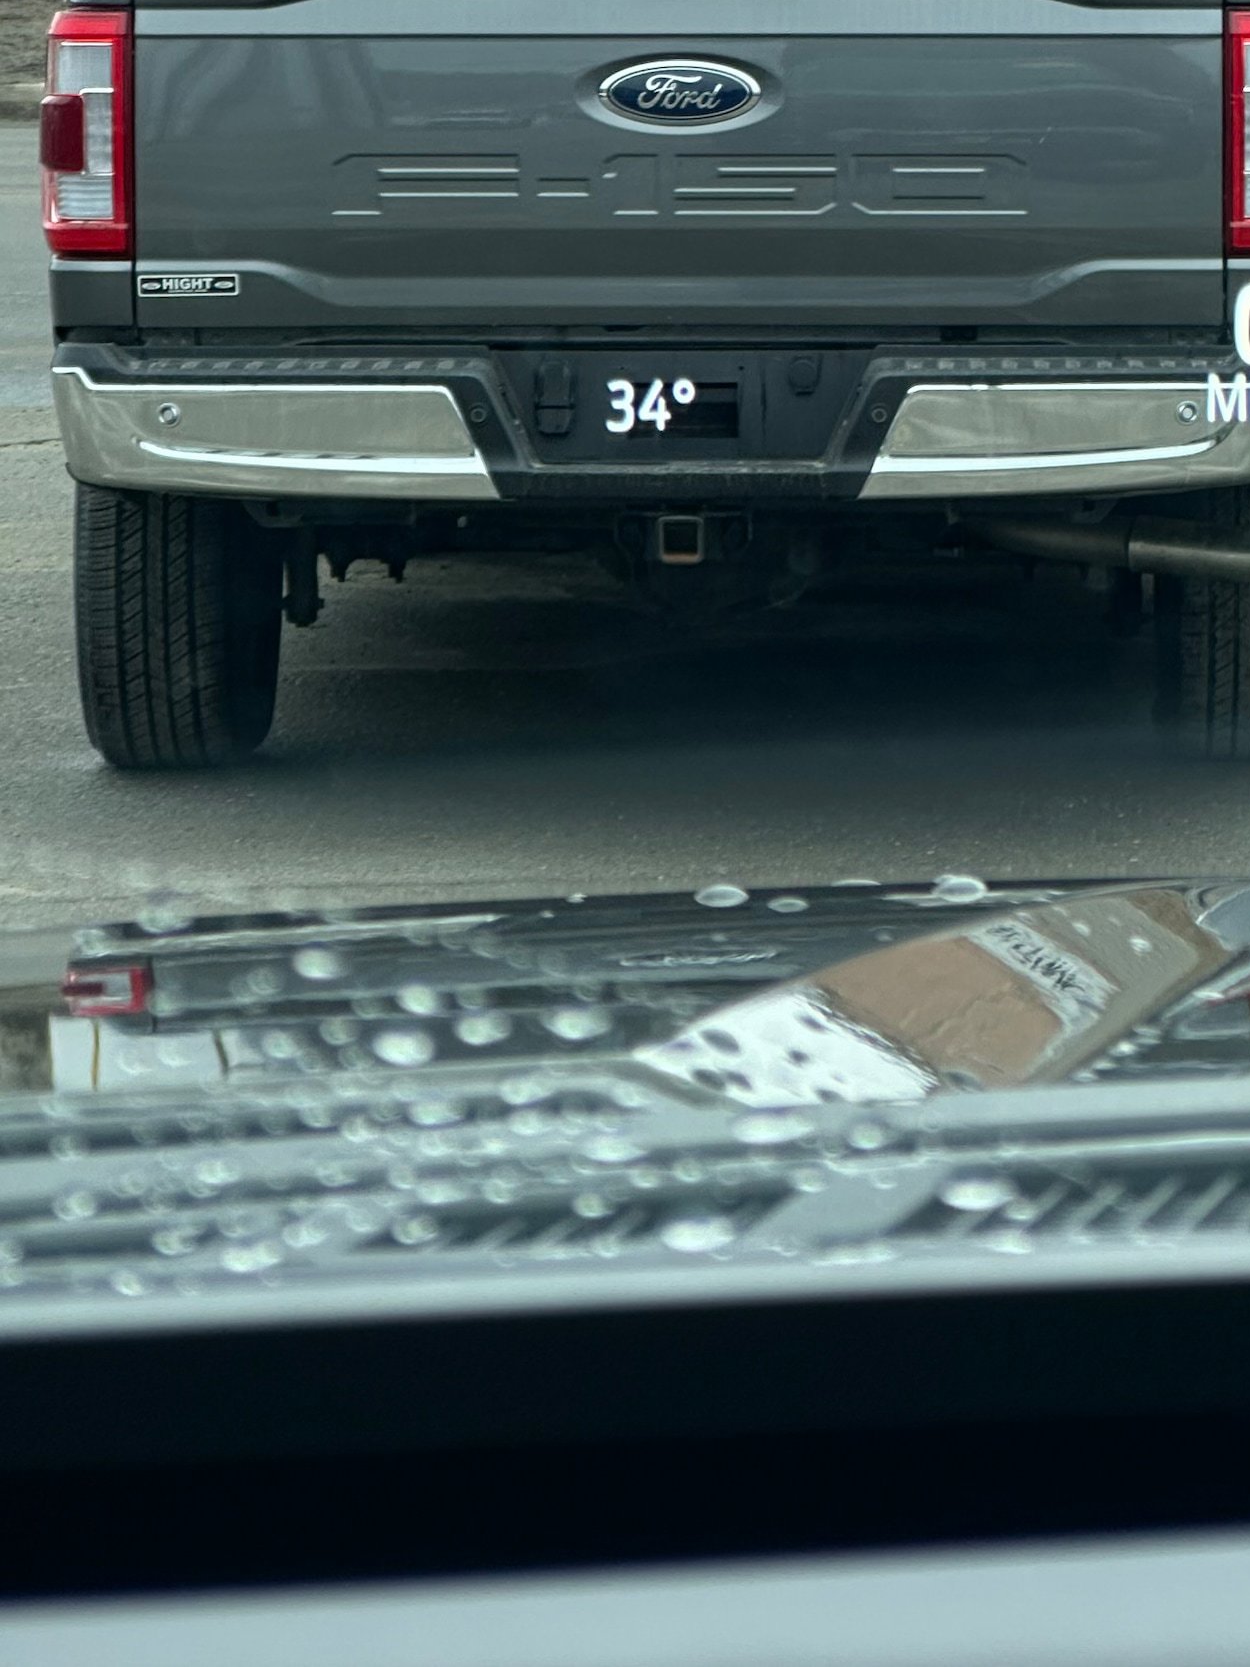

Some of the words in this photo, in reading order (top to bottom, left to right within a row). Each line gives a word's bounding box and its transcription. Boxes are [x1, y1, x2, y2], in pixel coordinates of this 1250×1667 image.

[637, 73, 724, 110] Ford
[331, 153, 1028, 215] F-150
[162, 277, 214, 290] HIGHT
[605, 378, 697, 433] 34°
